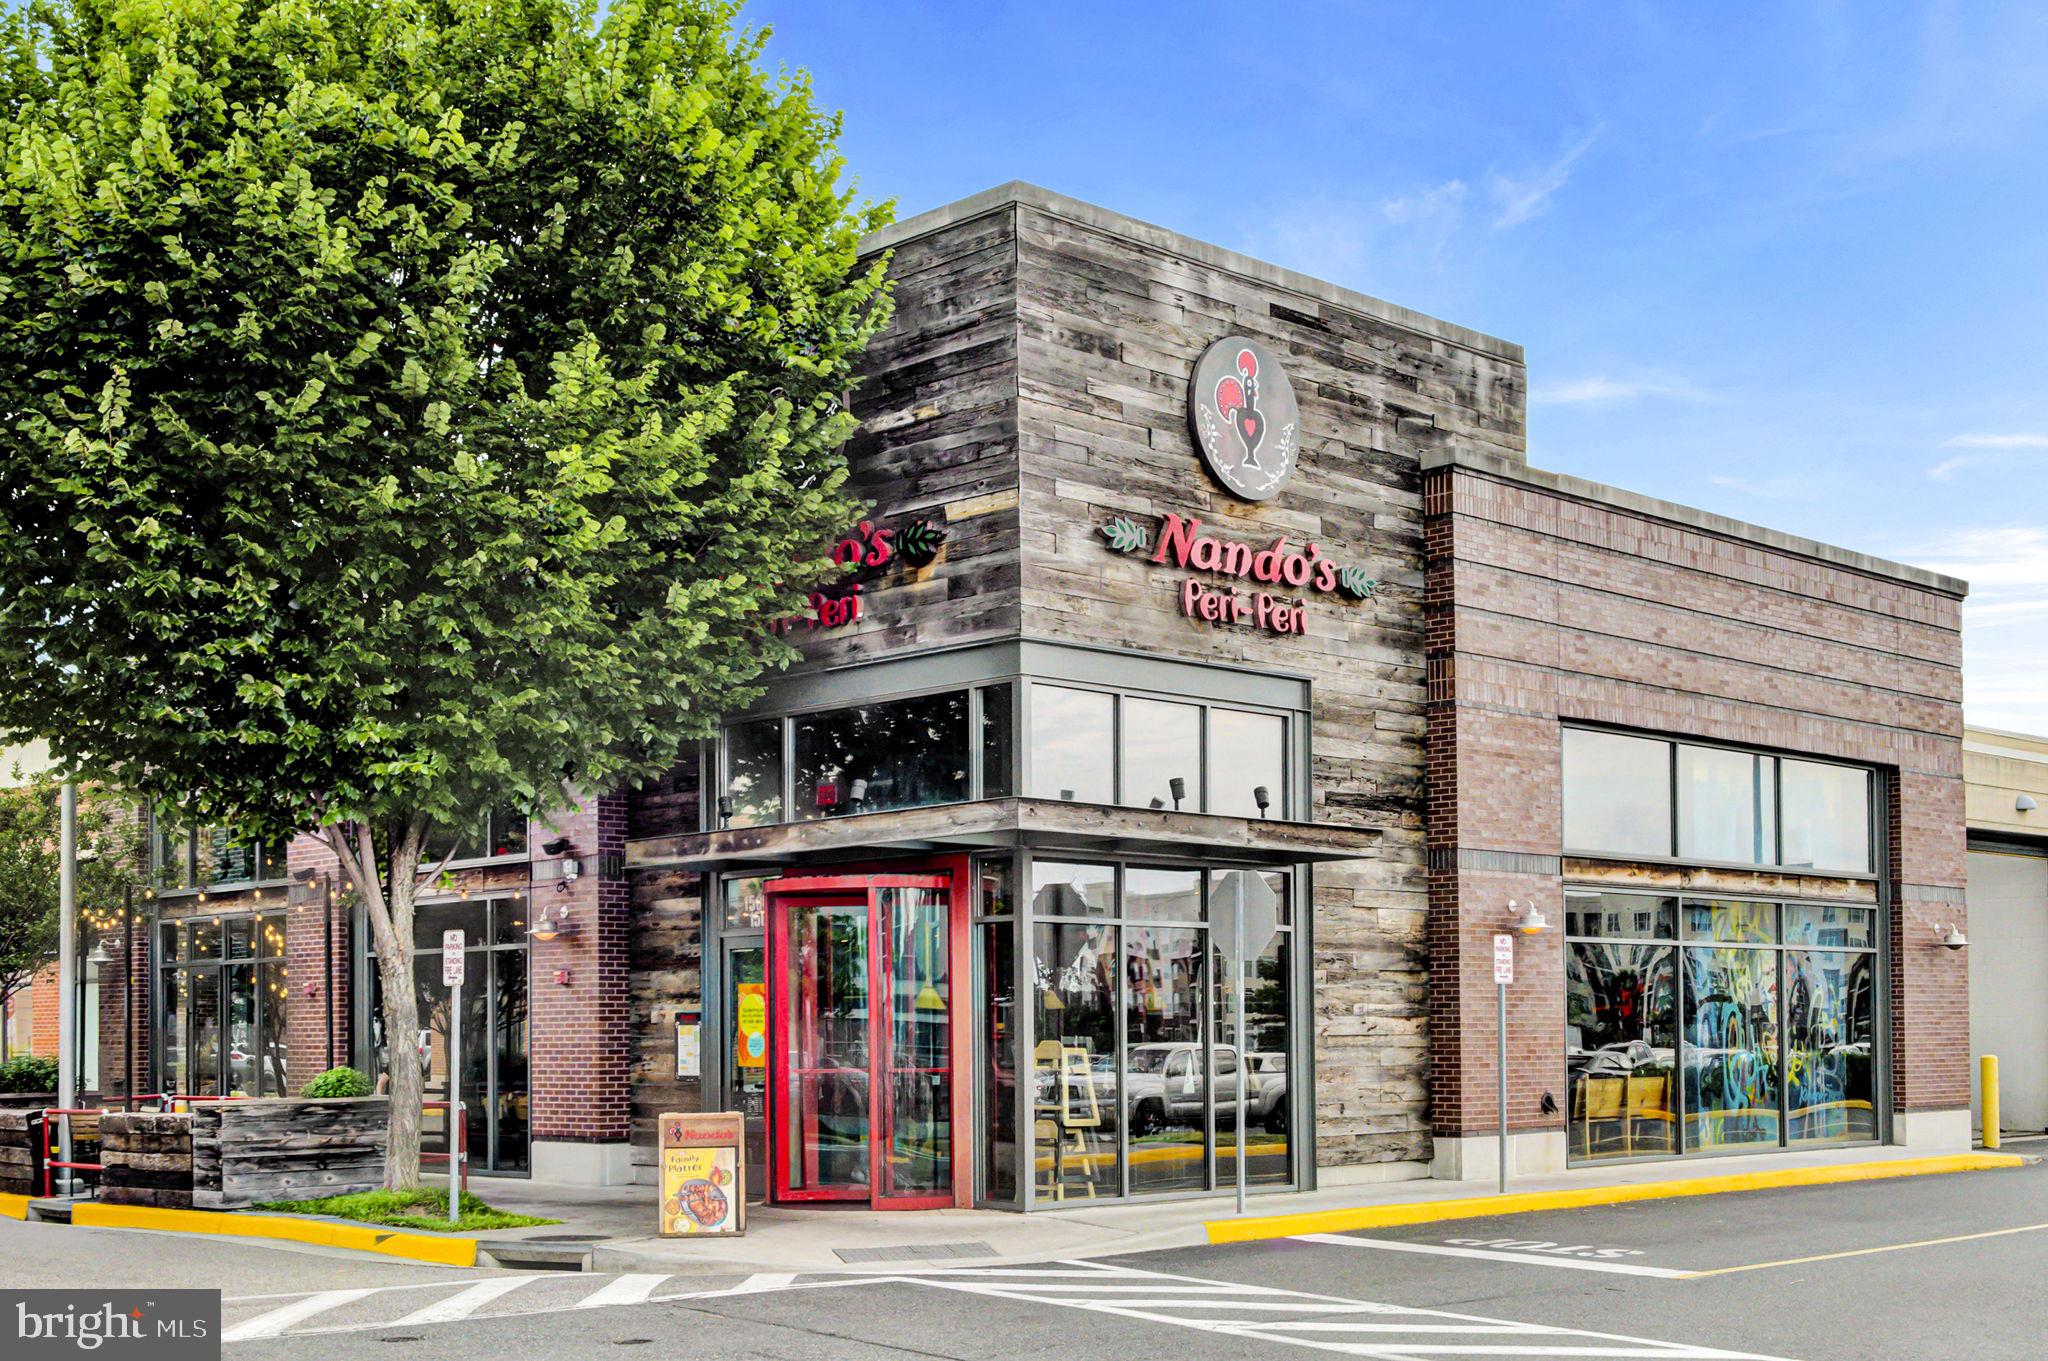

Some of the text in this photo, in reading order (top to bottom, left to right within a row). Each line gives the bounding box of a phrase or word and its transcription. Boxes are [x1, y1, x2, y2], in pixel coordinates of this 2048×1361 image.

[1152, 513, 1337, 593] Nando's
[1182, 577, 1308, 636] Peri-Peri
[445, 943, 462, 951] PARKING
[445, 957, 462, 965] STANDING
[445, 966, 462, 975] FIRE LANE
[671, 1155, 699, 1163] Family
[668, 1164, 703, 1173] Platter
